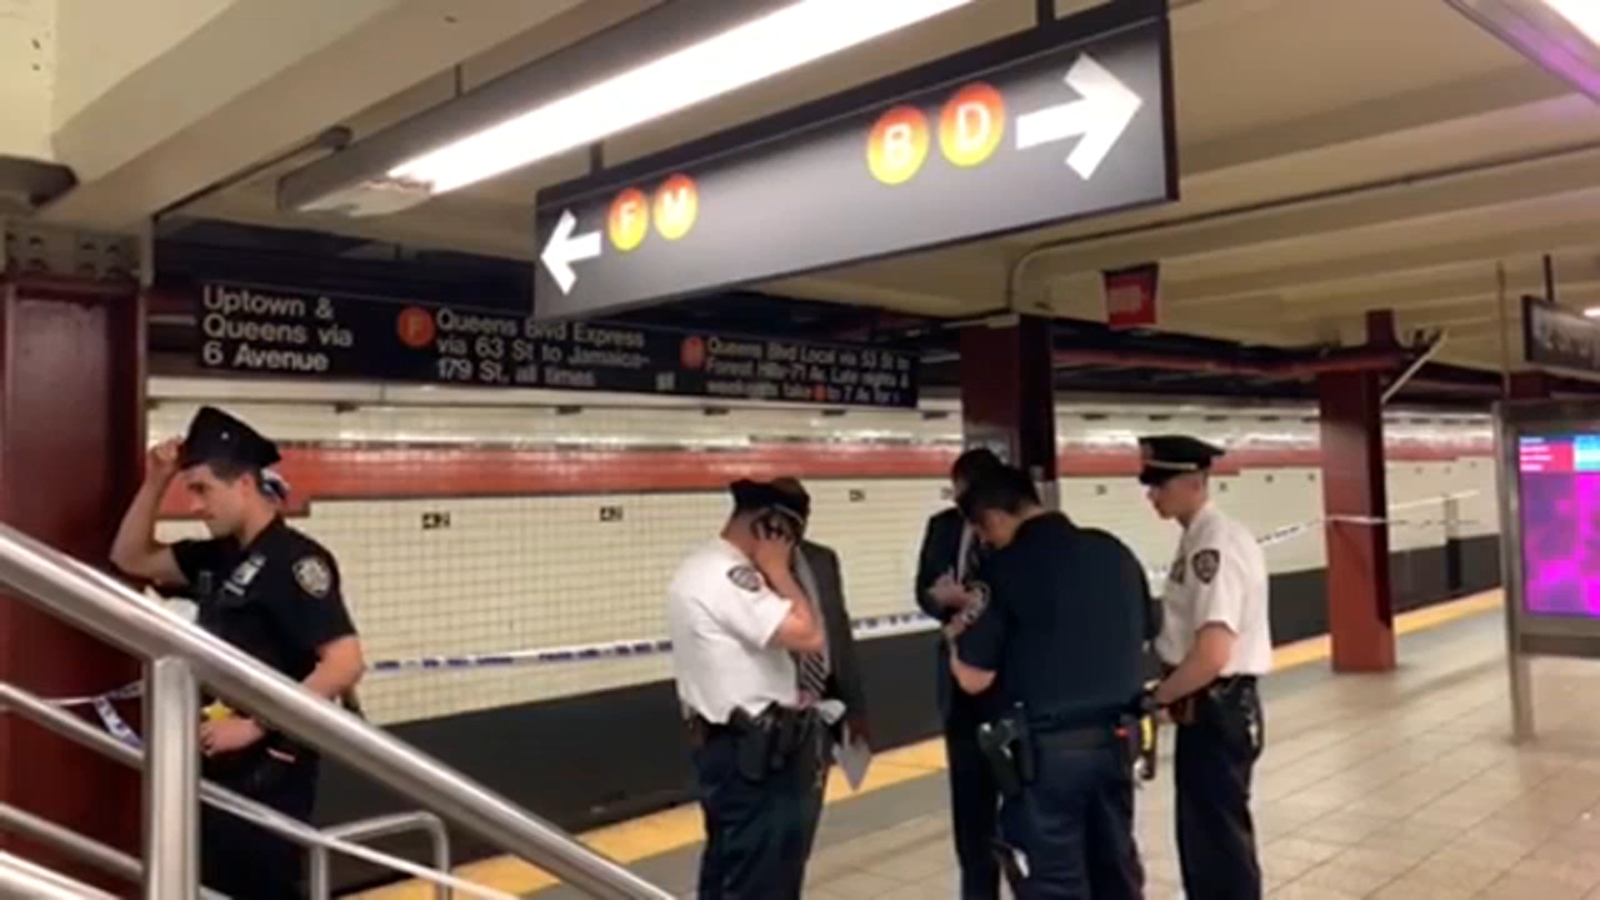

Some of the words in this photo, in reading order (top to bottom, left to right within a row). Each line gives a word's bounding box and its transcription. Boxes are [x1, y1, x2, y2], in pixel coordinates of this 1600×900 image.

[884, 122, 914, 170] B
[955, 101, 990, 151] D
[619, 200, 637, 236] F
[203, 285, 306, 317] Uptown
[315, 297, 334, 319] &
[203, 313, 308, 344] Queens
[317, 324, 353, 348] via
[437, 308, 517, 337] Queens
[573, 322, 645, 348] Express
[203, 340, 224, 366] 6
[232, 342, 330, 372] Avenue
[437, 336, 468, 356] via
[474, 337, 505, 359] 63
[511, 339, 535, 362] St
[541, 344, 563, 364] to
[707, 337, 763, 358] Queens
[766, 342, 797, 361] Blvd
[801, 345, 835, 364] Local
[438, 358, 473, 380] 179
[516, 364, 538, 383] all
[421, 511, 451, 530] 42
